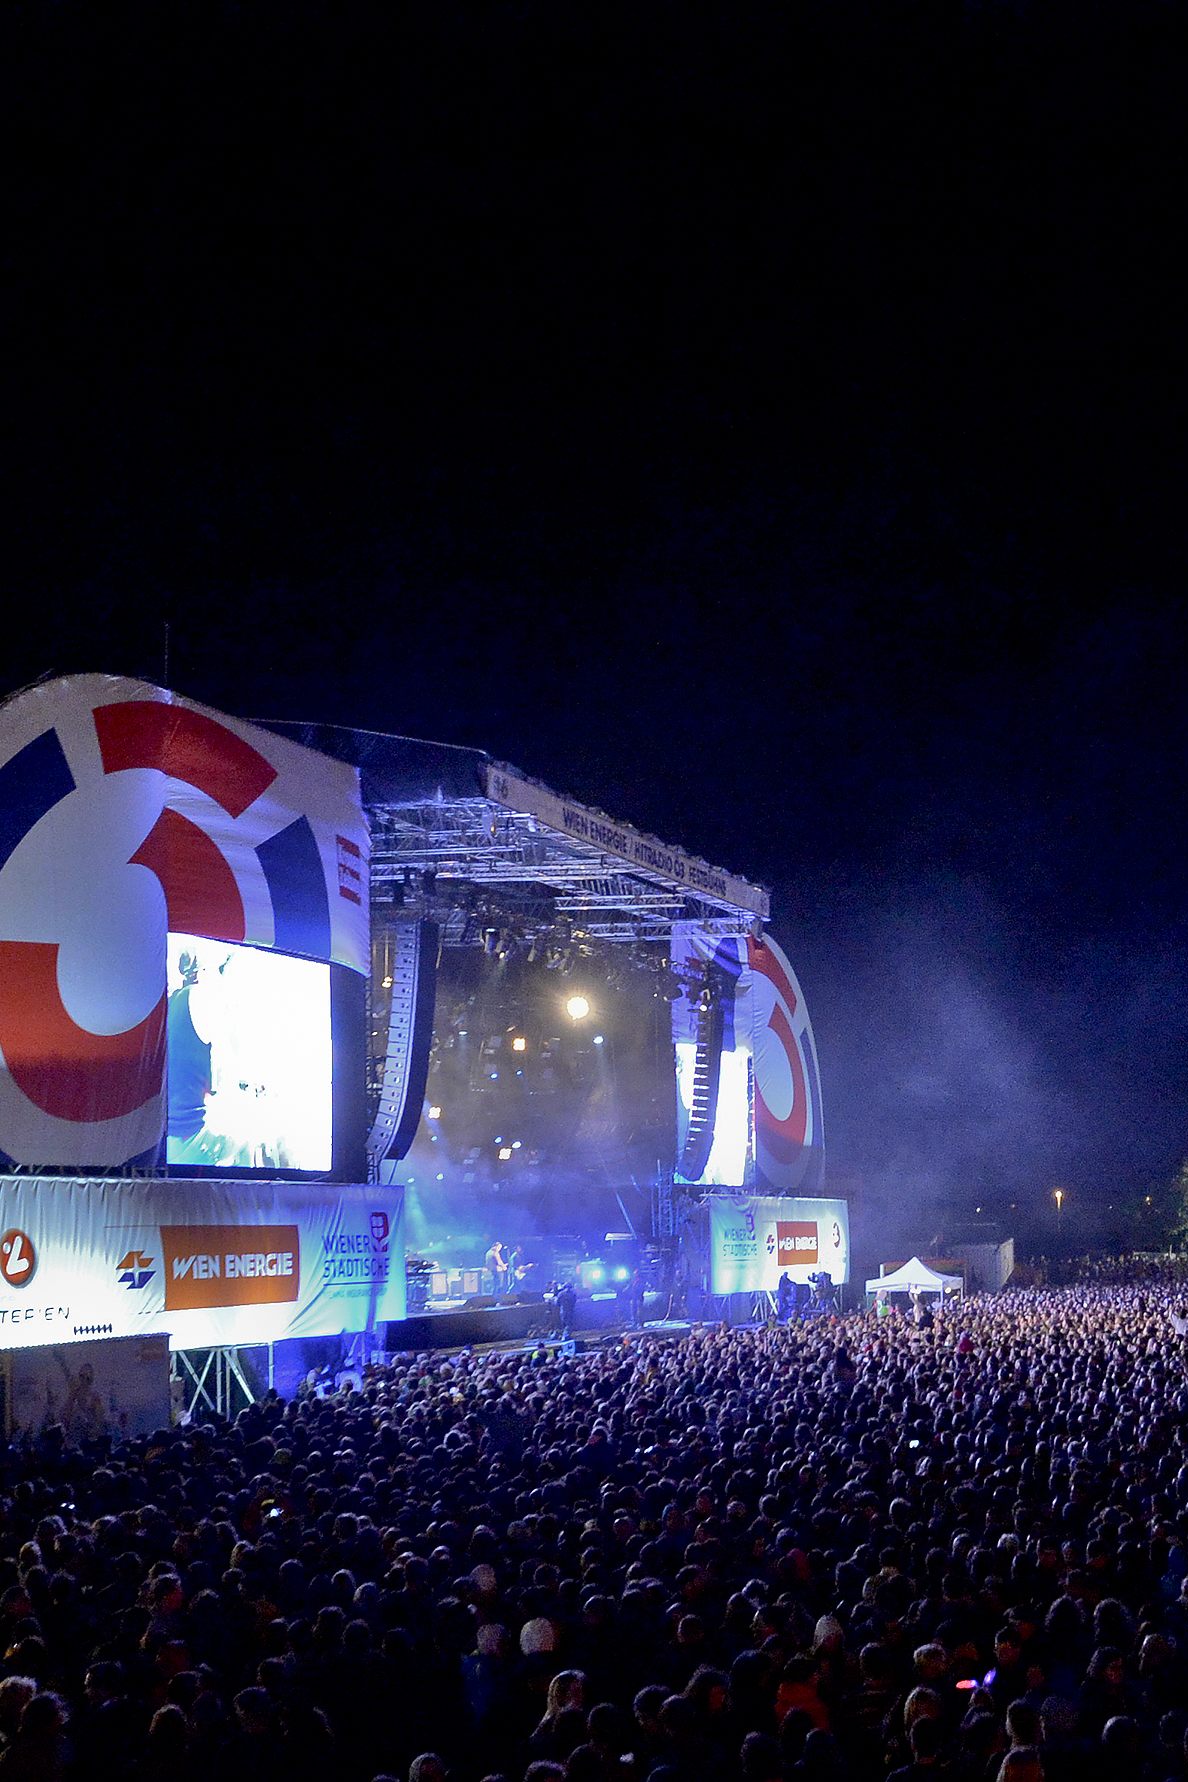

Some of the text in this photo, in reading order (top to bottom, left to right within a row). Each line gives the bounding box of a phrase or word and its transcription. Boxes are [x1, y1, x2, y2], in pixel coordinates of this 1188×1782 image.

[562, 807, 588, 835] WIEN
[590, 820, 627, 853] ENERGIE
[321, 1234, 371, 1255] WIENER
[172, 1252, 294, 1281] WIEN ENERGIE
